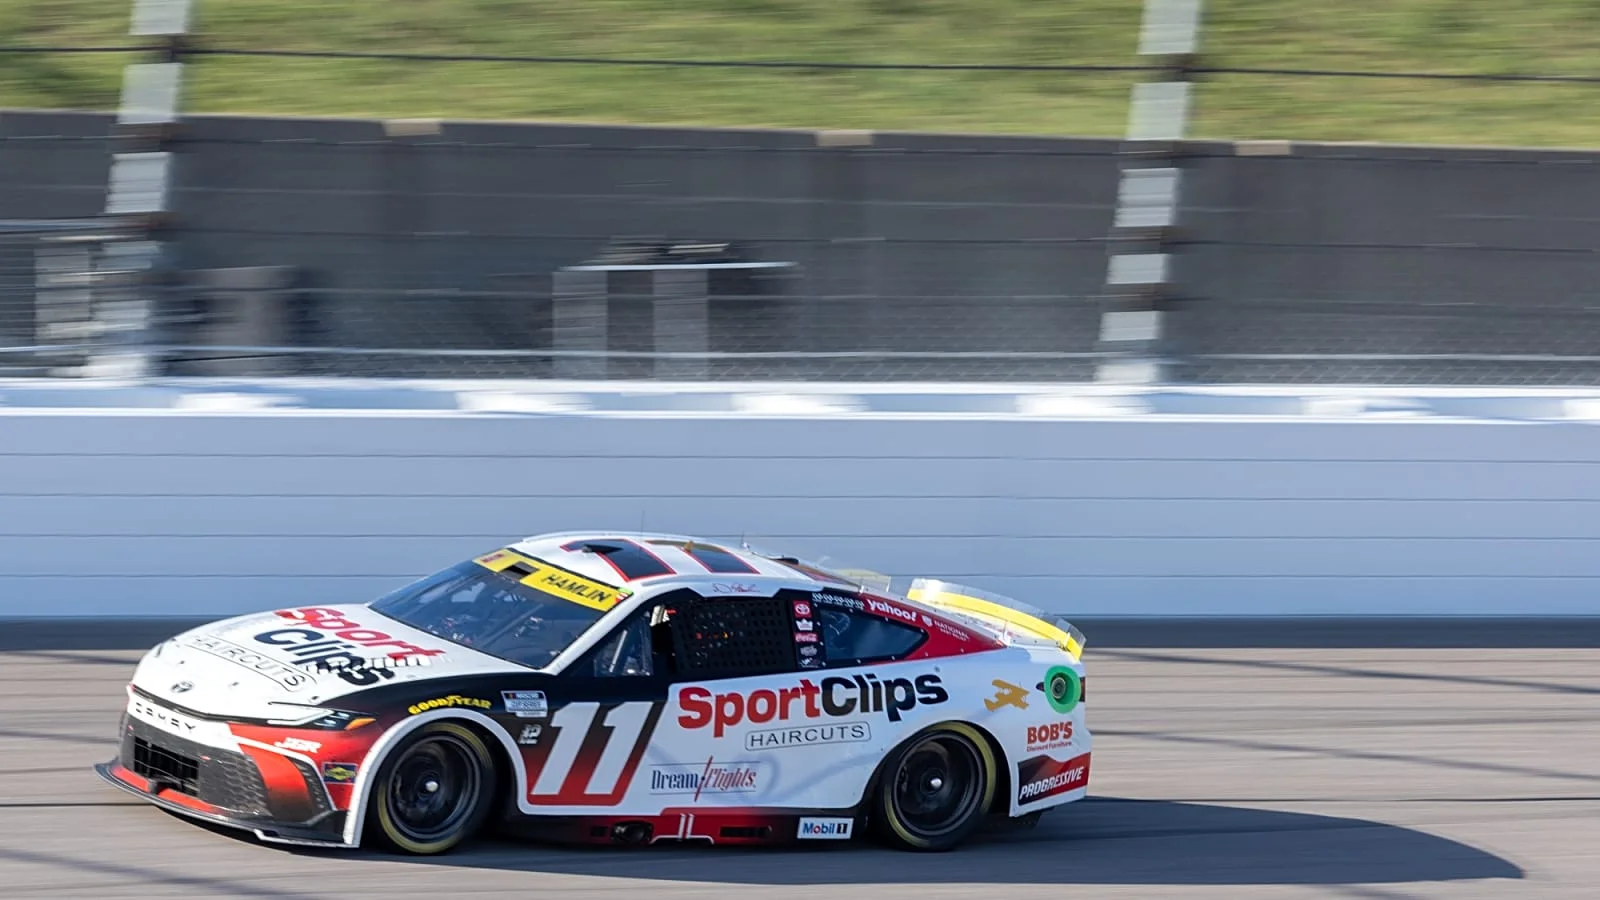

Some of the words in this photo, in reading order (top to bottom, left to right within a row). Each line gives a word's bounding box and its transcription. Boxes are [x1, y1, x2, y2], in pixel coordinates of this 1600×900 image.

[541, 573, 613, 603] HAMLIN
[867, 598, 917, 622] yahoo!
[408, 695, 492, 715] GOODYEAR
[751, 725, 864, 747] HAIRCUTS
[1026, 721, 1073, 744] BOB'S
[531, 701, 654, 796] 11
[1019, 766, 1085, 800] PROGRESSIVE
[802, 822, 835, 835] Mobil
[836, 822, 848, 834] 1
